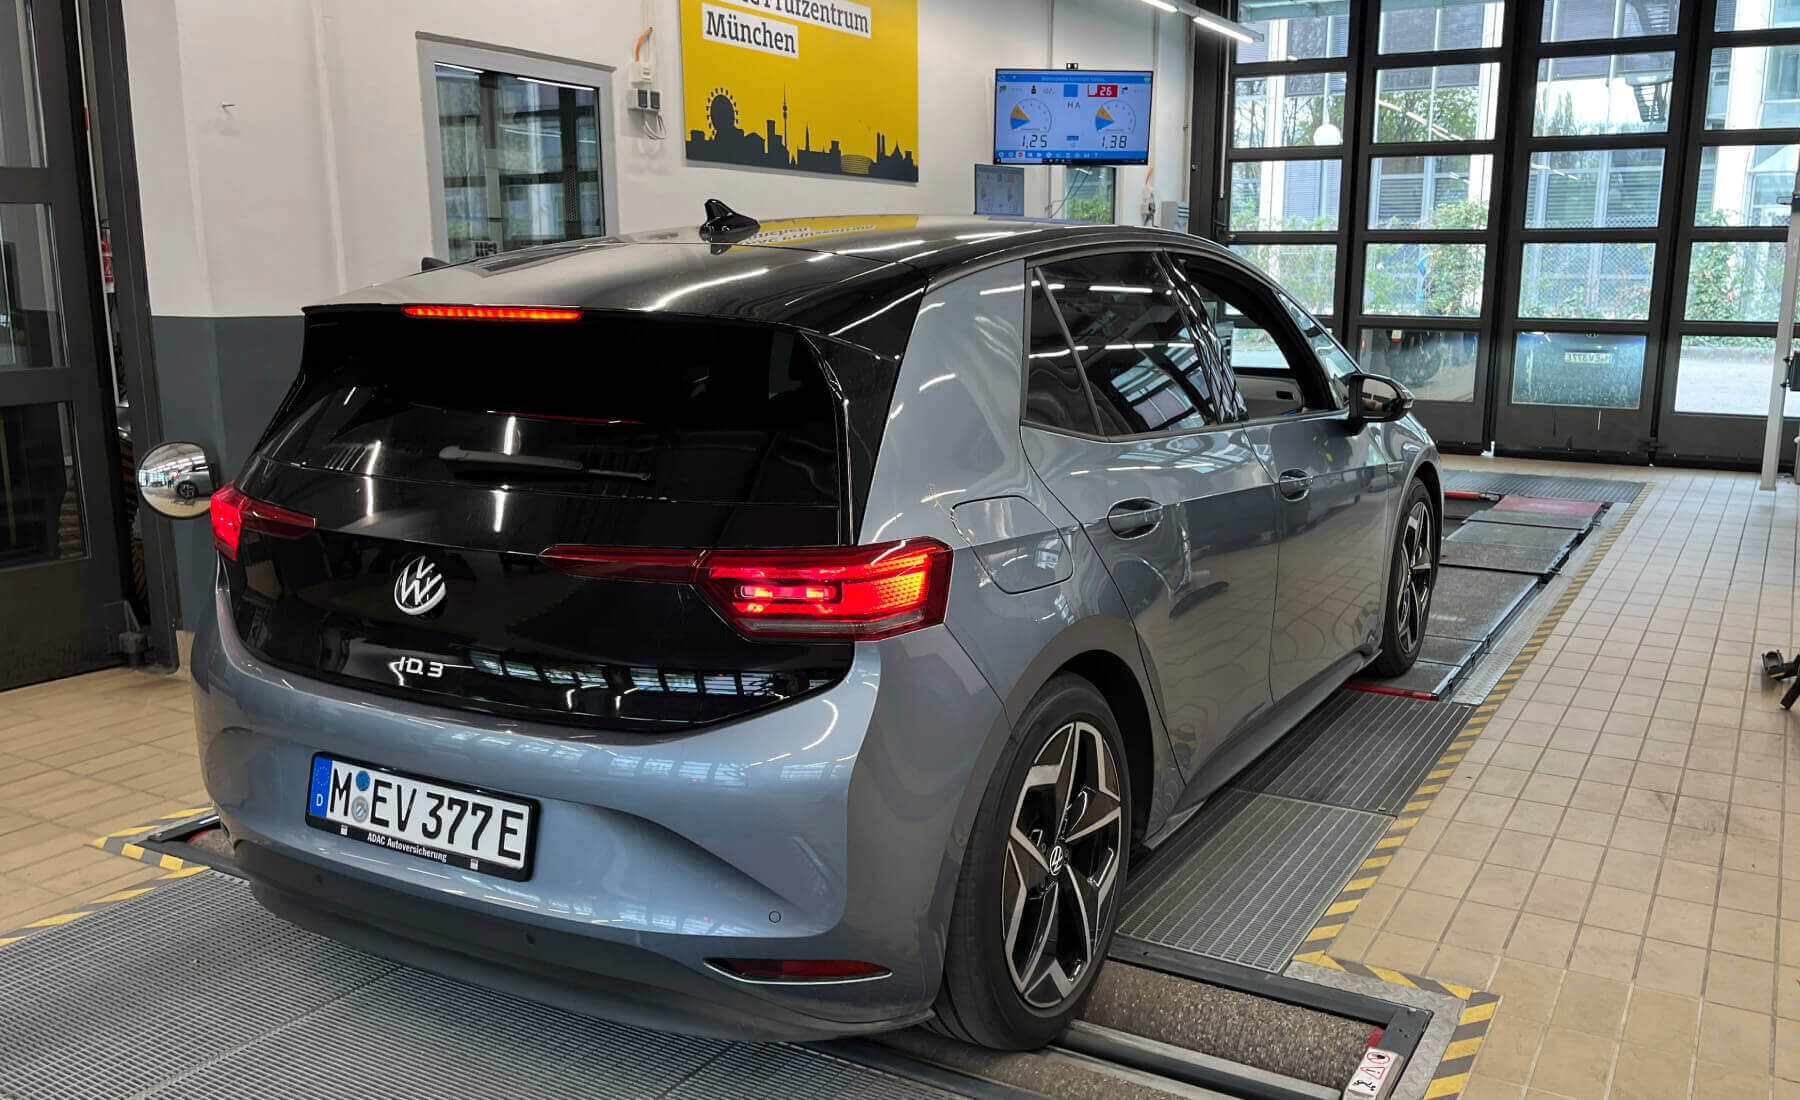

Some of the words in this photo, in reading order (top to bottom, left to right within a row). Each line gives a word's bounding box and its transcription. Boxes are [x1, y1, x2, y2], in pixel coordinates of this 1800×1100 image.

[706, 11, 796, 53] München
[1099, 86, 1112, 96] 26
[316, 793, 324, 807] D
[329, 768, 352, 817] M
[370, 779, 417, 832] EV
[367, 832, 386, 846] ADAC
[386, 838, 448, 863] Autoversicherung
